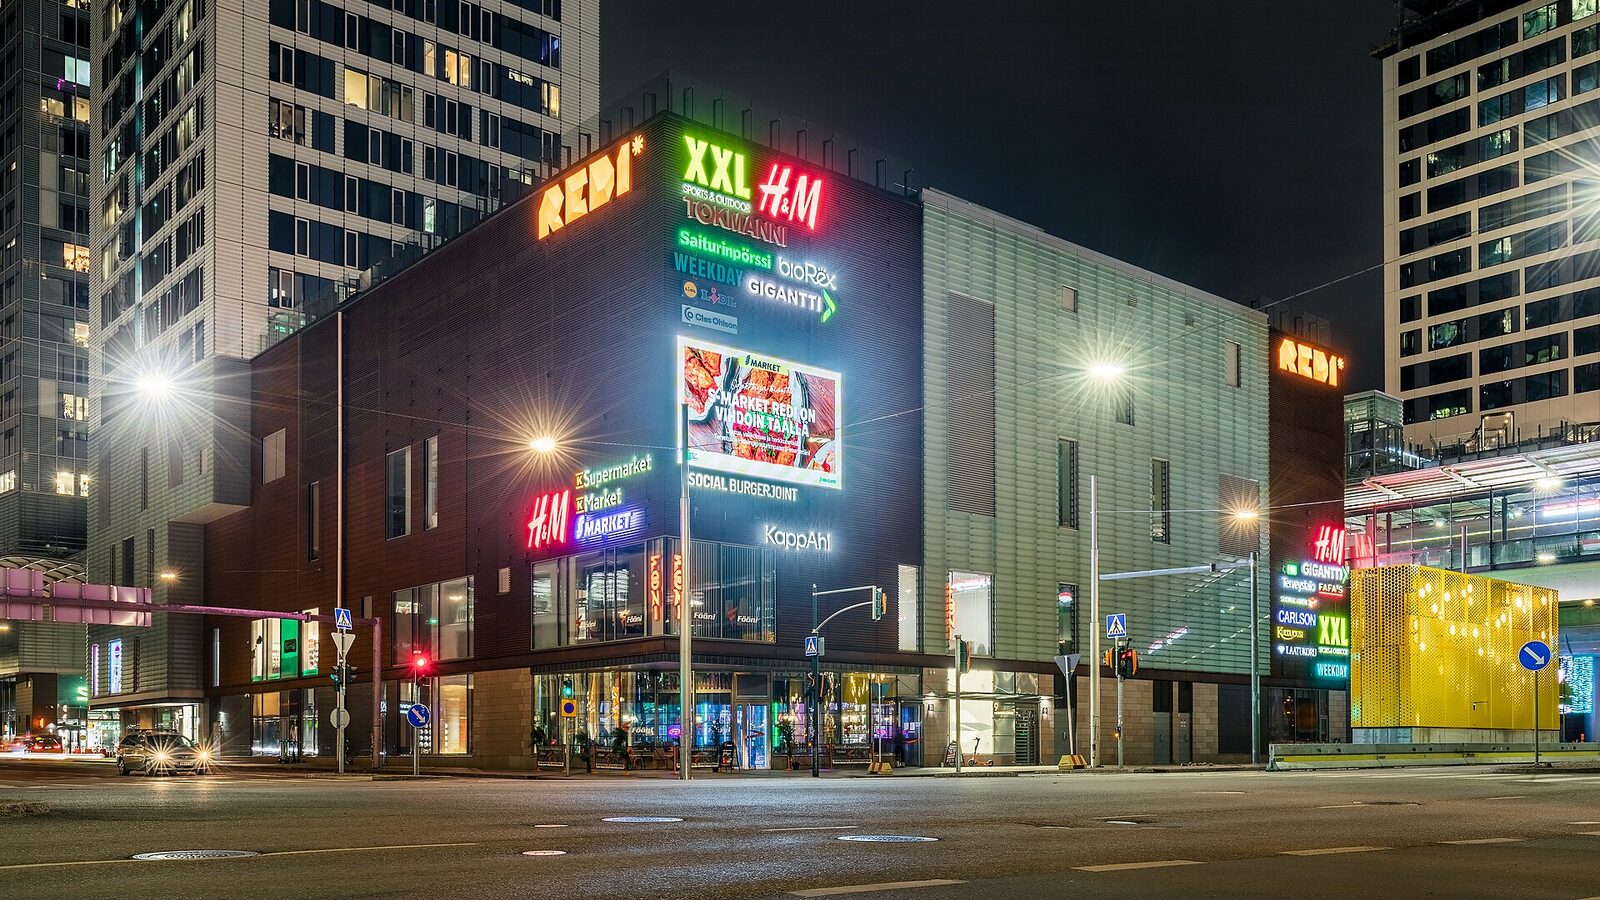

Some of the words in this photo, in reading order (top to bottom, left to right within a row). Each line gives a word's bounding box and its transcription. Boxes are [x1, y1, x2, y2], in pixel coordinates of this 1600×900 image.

[683, 135, 751, 199] XXL
[682, 184, 708, 199] SPORTS
[709, 191, 716, 202] &
[716, 193, 751, 213] OUTDOOR
[759, 164, 823, 230] H&M
[683, 196, 788, 248] TOKMANNI
[679, 230, 772, 270] Saiturinpörssi
[673, 251, 744, 287] WEEKDAY
[747, 278, 822, 313] GIGANTTI
[695, 313, 712, 324] Clas
[712, 317, 738, 330] Ohlson
[750, 360, 781, 373] MARKET
[707, 388, 769, 414] S-MARKET
[801, 408, 816, 423] ON
[715, 405, 765, 428] VIHDOIN
[767, 415, 810, 438] TÄÄLLÄ
[584, 454, 653, 488] Supermarket
[688, 471, 728, 492] SOCIAL
[729, 481, 798, 502] BURGERJOINT
[584, 488, 622, 513] Market
[527, 489, 569, 549] H&M
[765, 525, 832, 552] KappAhl
[1315, 525, 1345, 565] H&M
[1302, 562, 1343, 581] GIGANTTI
[1278, 609, 1317, 627] CARLSON
[1318, 615, 1349, 646] XXL
[1317, 663, 1347, 678] WEEKDAY
